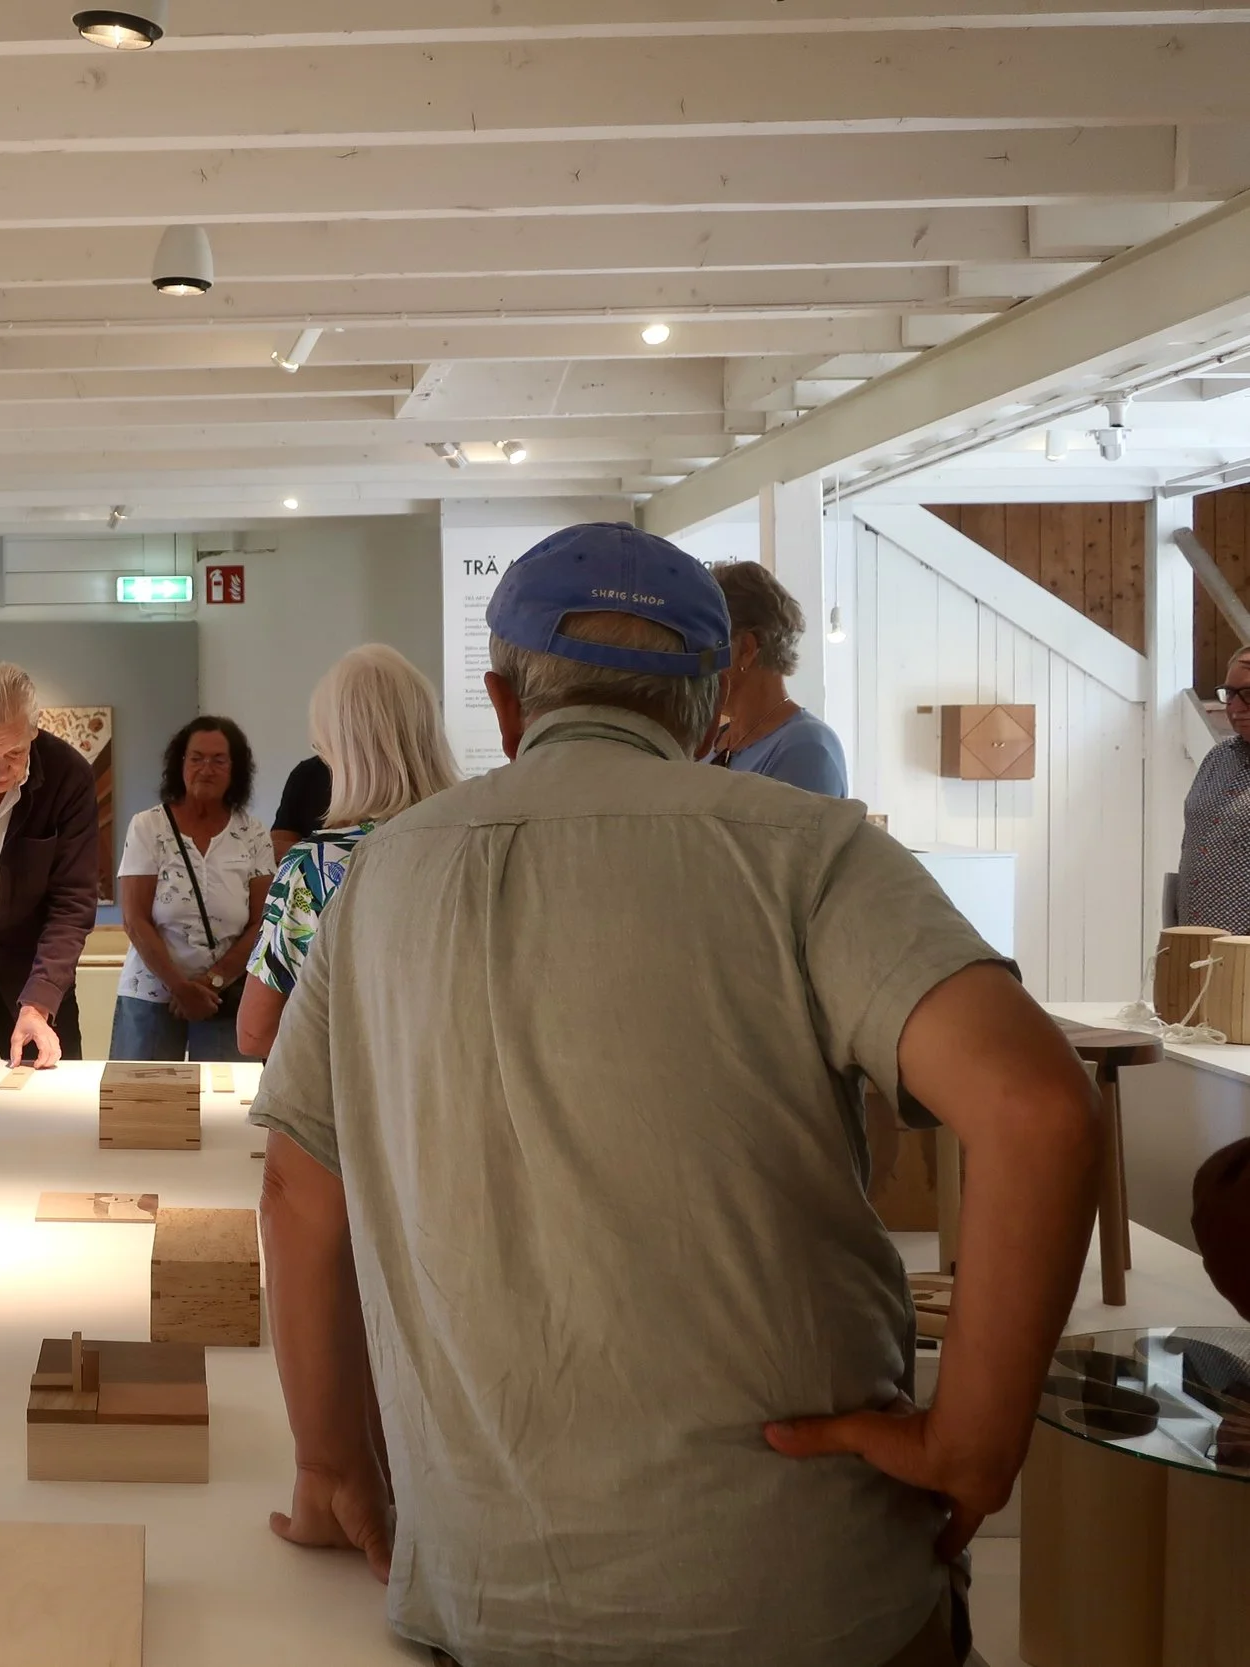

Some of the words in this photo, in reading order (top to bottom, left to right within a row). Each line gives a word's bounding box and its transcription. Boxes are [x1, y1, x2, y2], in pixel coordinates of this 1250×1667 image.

[463, 555, 499, 575] TRÄ
[591, 589, 627, 600] SHRIG
[632, 593, 665, 606] SHOP
